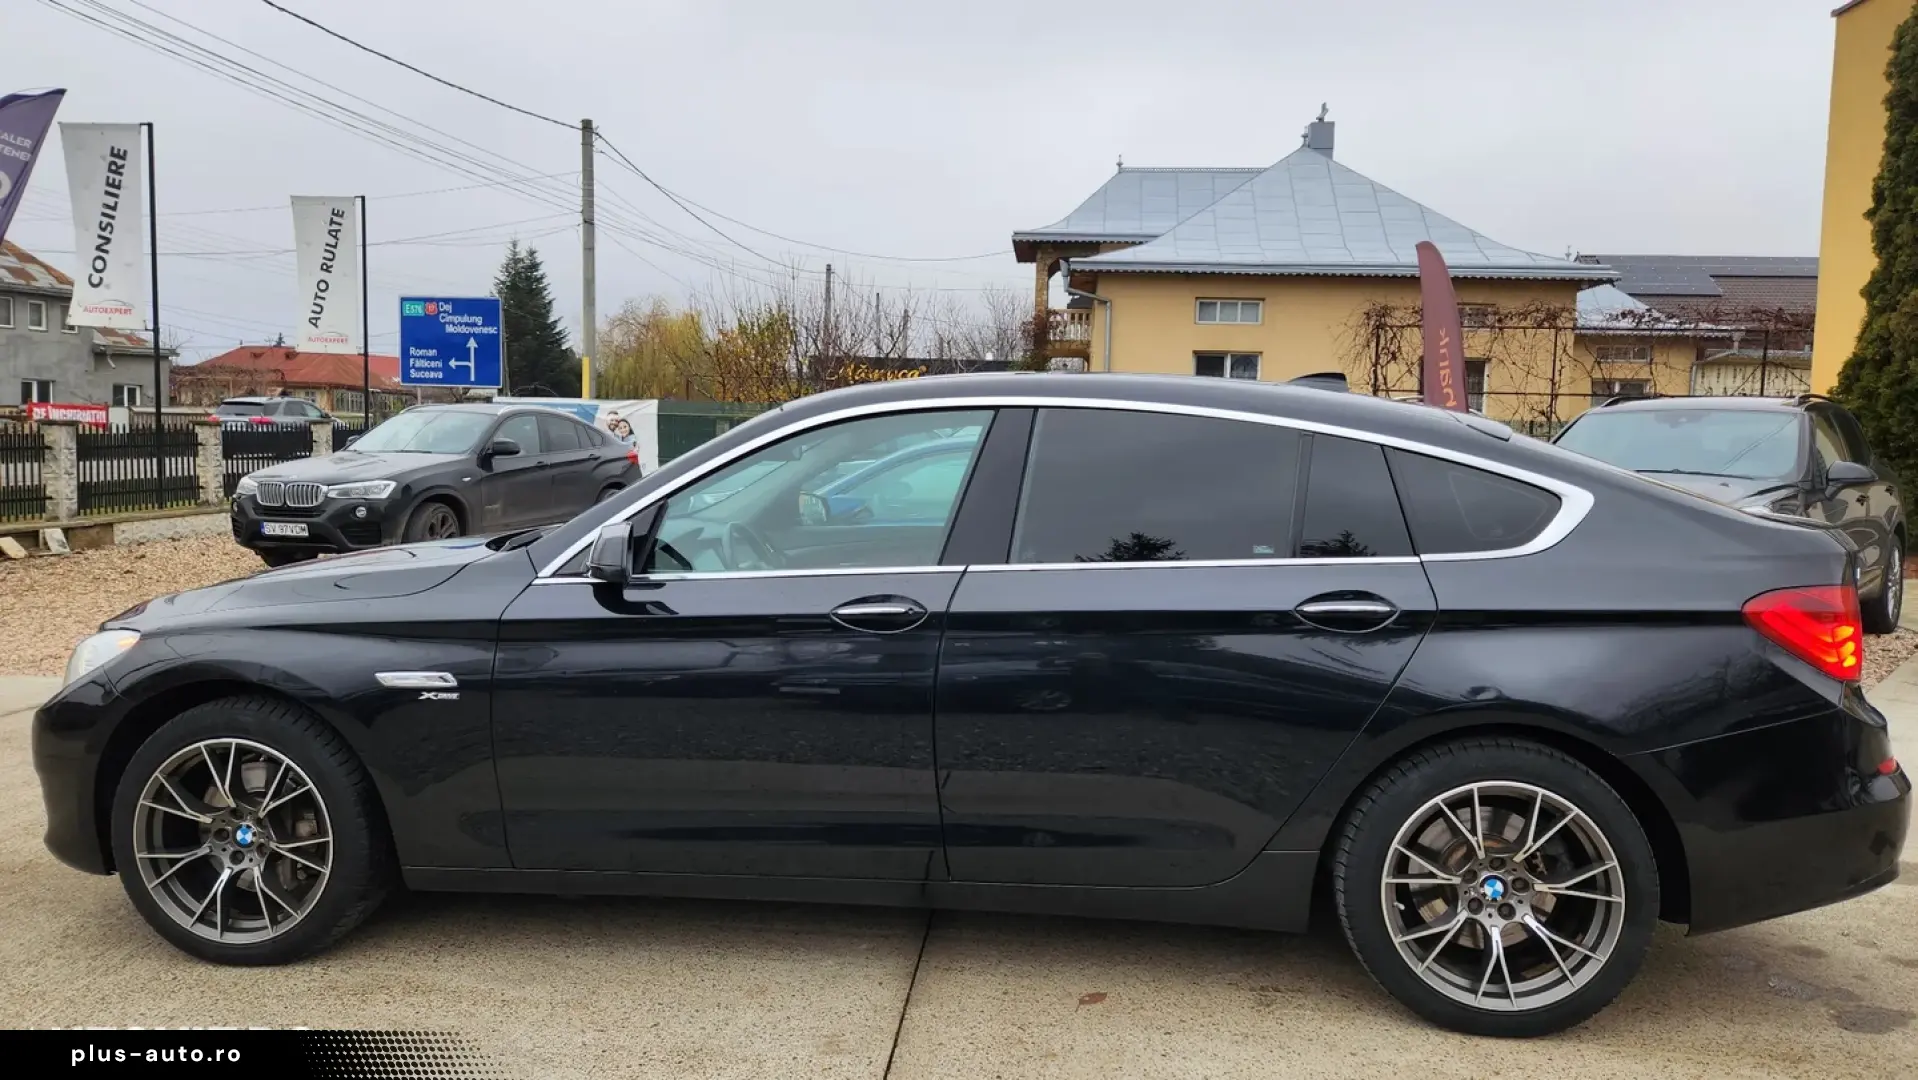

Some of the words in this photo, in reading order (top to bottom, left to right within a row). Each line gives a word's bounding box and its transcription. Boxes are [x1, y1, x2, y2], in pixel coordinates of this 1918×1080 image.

[0, 131, 32, 149] ALER
[88, 145, 128, 289] CONSILIERE
[308, 279, 329, 329] AUTO
[320, 207, 345, 274] RULATE
[83, 305, 132, 315] AUTOEXPERT
[439, 302, 452, 313] Dej
[445, 324, 498, 334] Moldovenesc
[409, 346, 438, 357] Roman
[409, 368, 443, 379] Suceava
